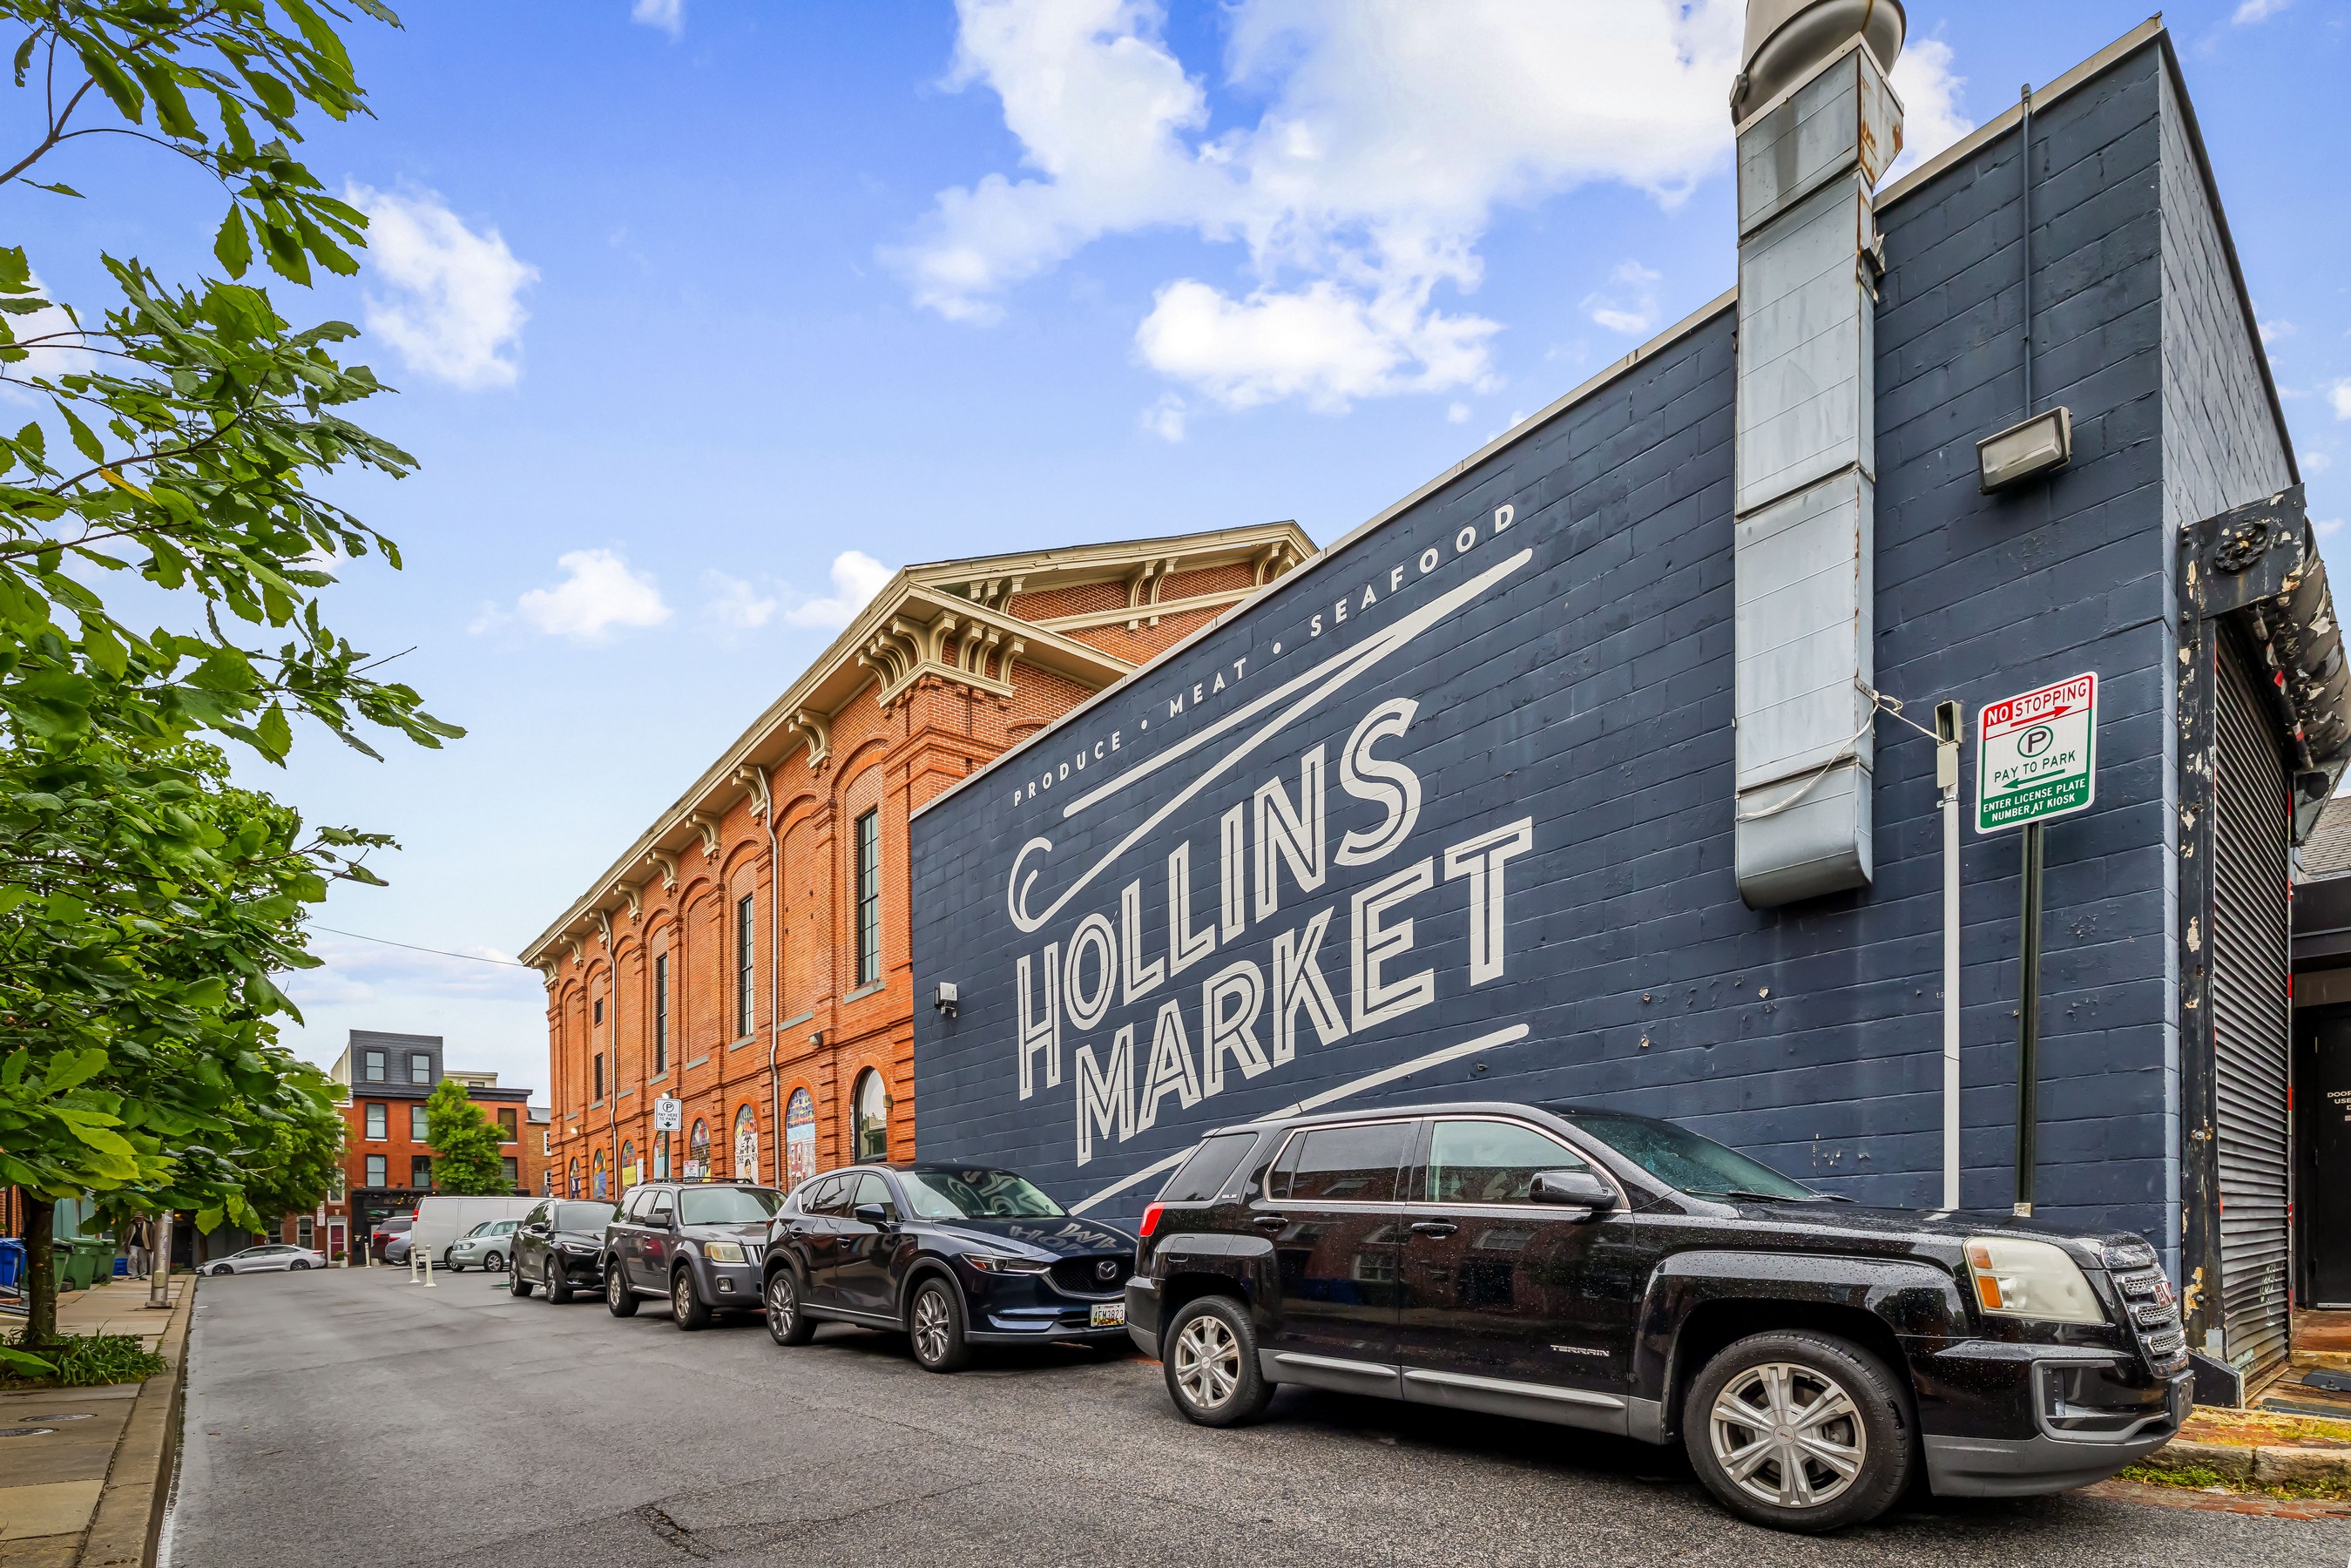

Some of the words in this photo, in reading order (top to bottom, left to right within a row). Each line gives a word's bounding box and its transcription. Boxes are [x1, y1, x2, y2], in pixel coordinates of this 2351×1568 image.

[1013, 730, 1121, 807] PRODUCE
[1169, 657, 1246, 719] MEAT
[1309, 503, 1516, 638] SEAFOOD
[1987, 706, 2010, 726] NO
[2015, 681, 2087, 718] STOPPING
[2028, 730, 2047, 754] P
[1994, 766, 2019, 783] PAY
[2023, 760, 2037, 774] TO
[2042, 749, 2076, 770] PARK
[1983, 797, 2011, 813] ENTER
[2014, 787, 2053, 805] LICENSE
[2056, 778, 2086, 794] PLATE
[1991, 804, 2030, 821] NUMBER
[2031, 801, 2044, 814] AT
[2046, 793, 2076, 808] KIOSK
[1017, 697, 1422, 1101] HOLLINS
[1076, 816, 1534, 1168] MARKET
[1550, 1344, 1610, 1357] TERRAIN
